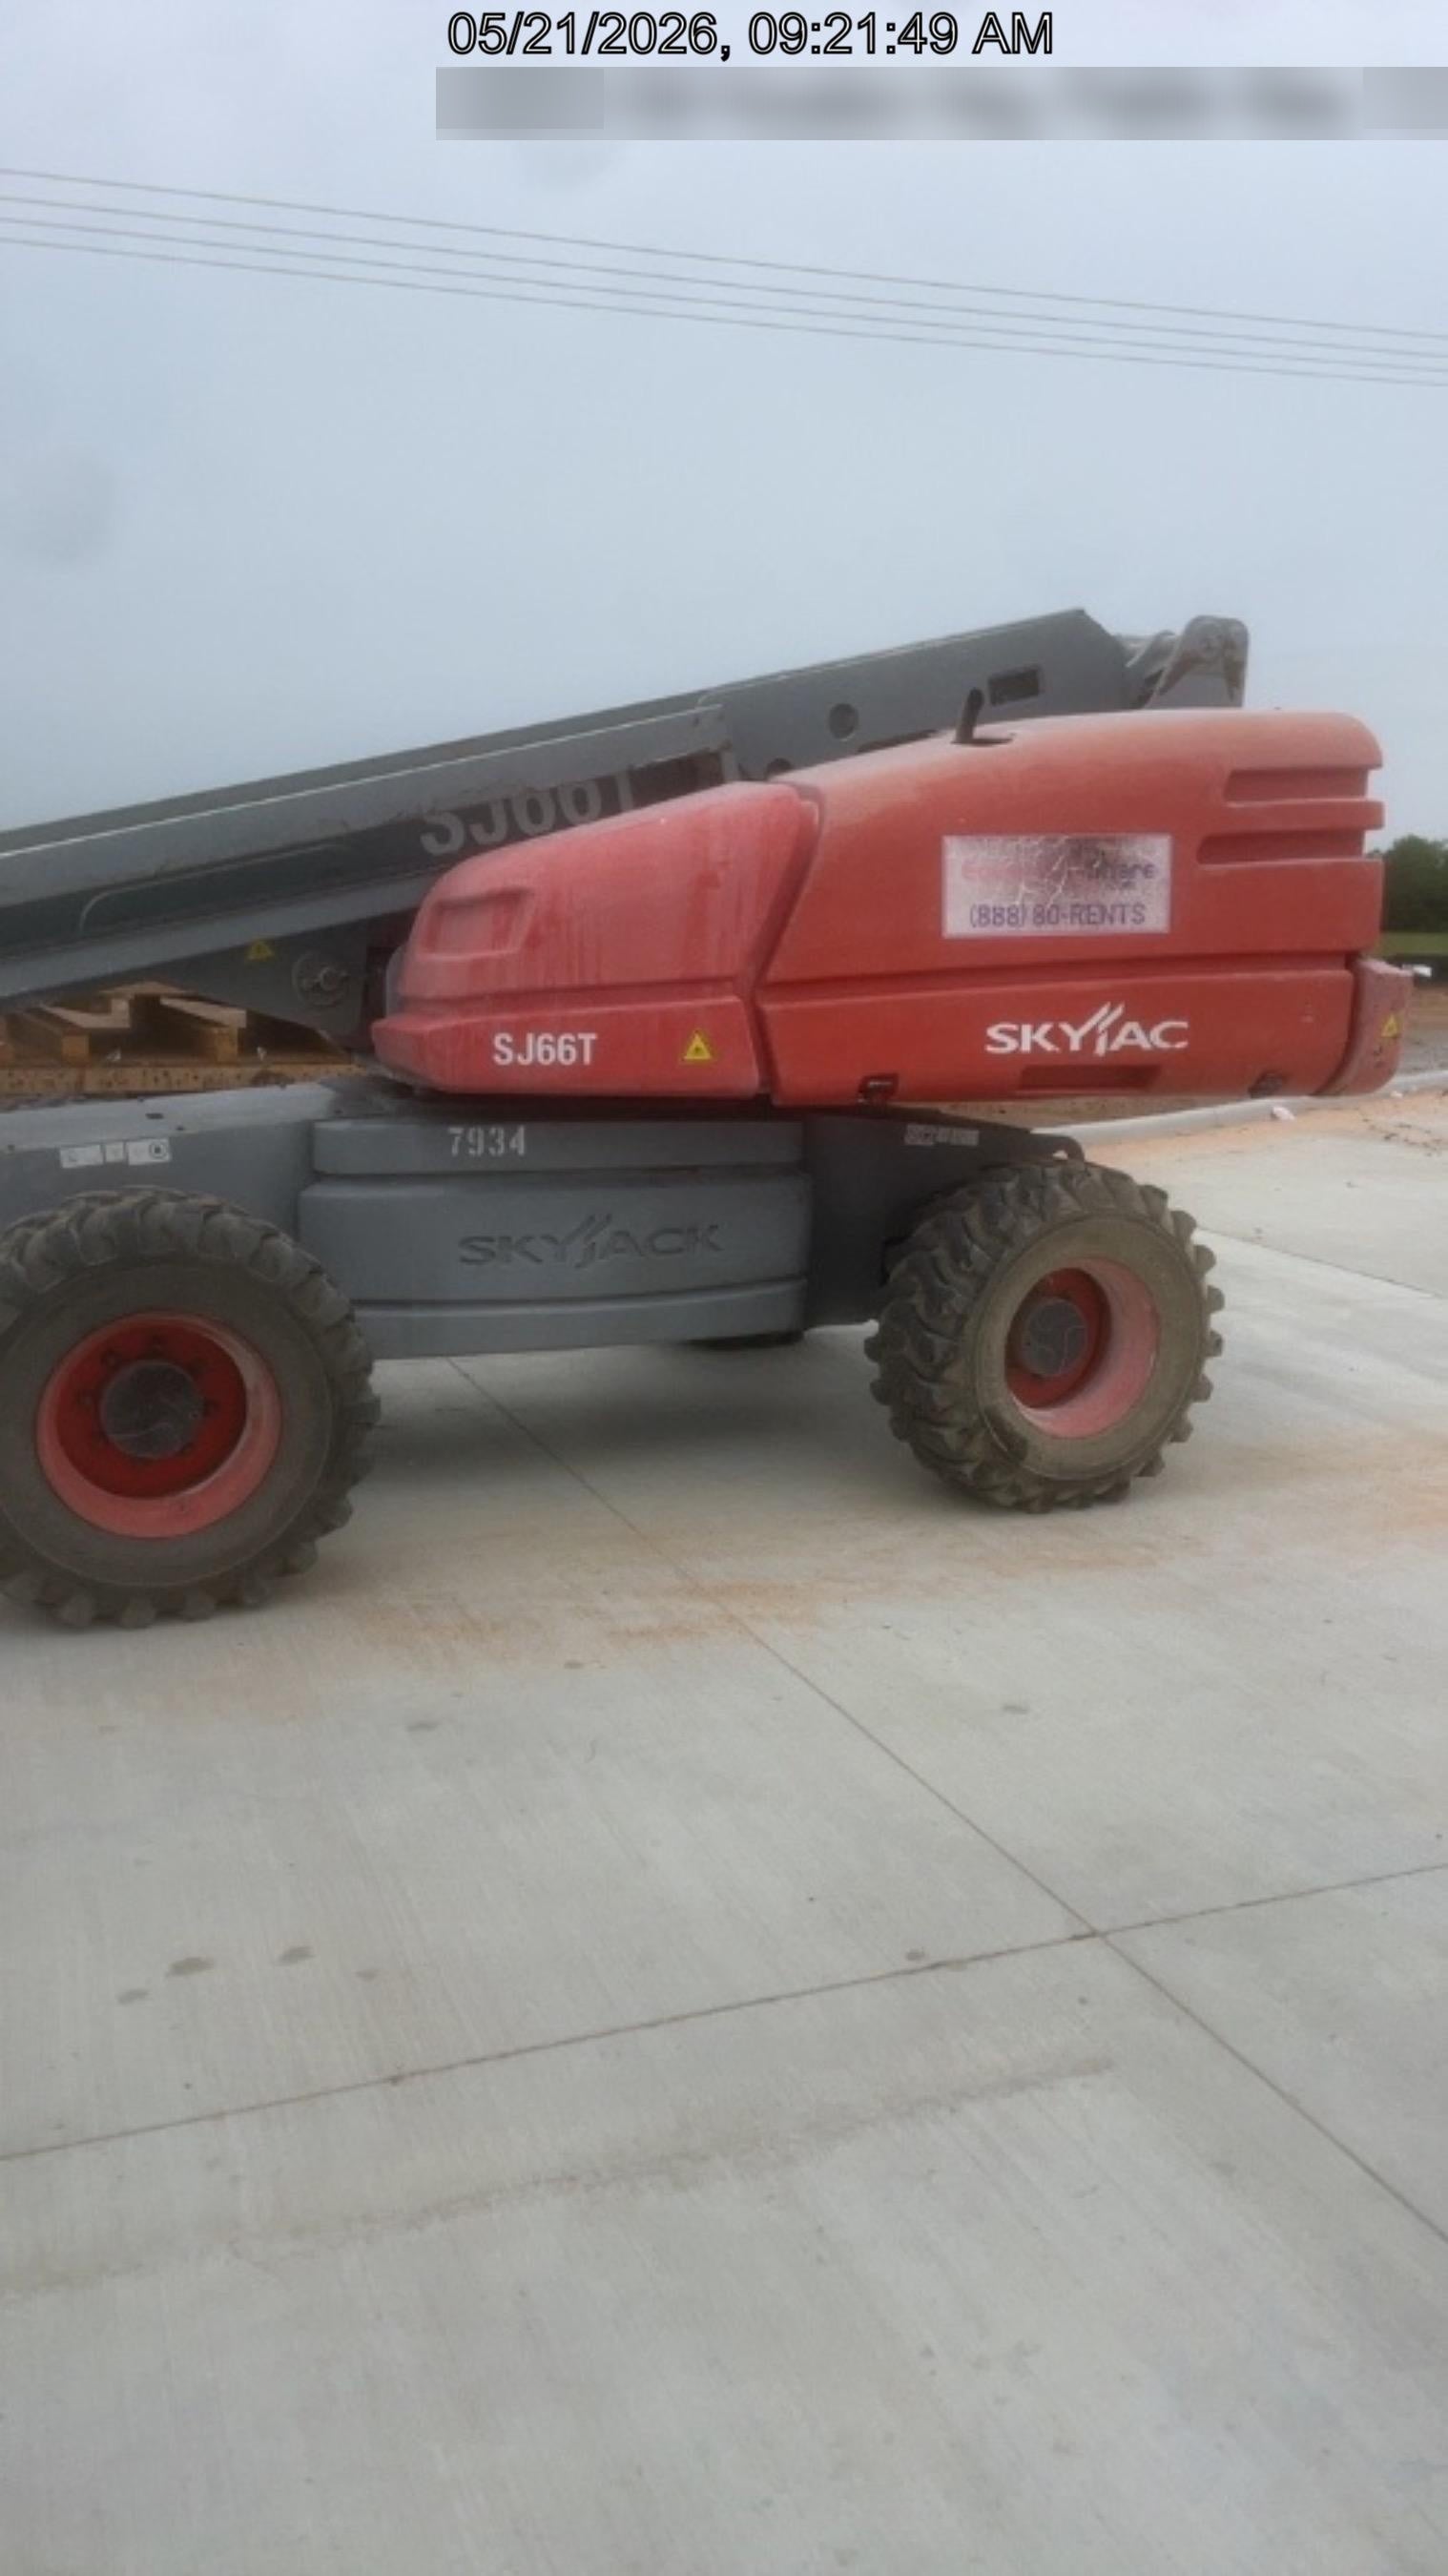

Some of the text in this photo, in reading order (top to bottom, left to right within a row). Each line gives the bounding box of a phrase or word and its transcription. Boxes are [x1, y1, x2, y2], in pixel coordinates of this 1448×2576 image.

[969, 902, 1147, 928] (888) 80-RENTS
[492, 1031, 598, 1066] SJ66T
[448, 1125, 526, 1156] 7934
[458, 1214, 725, 1269] SKYJACK
